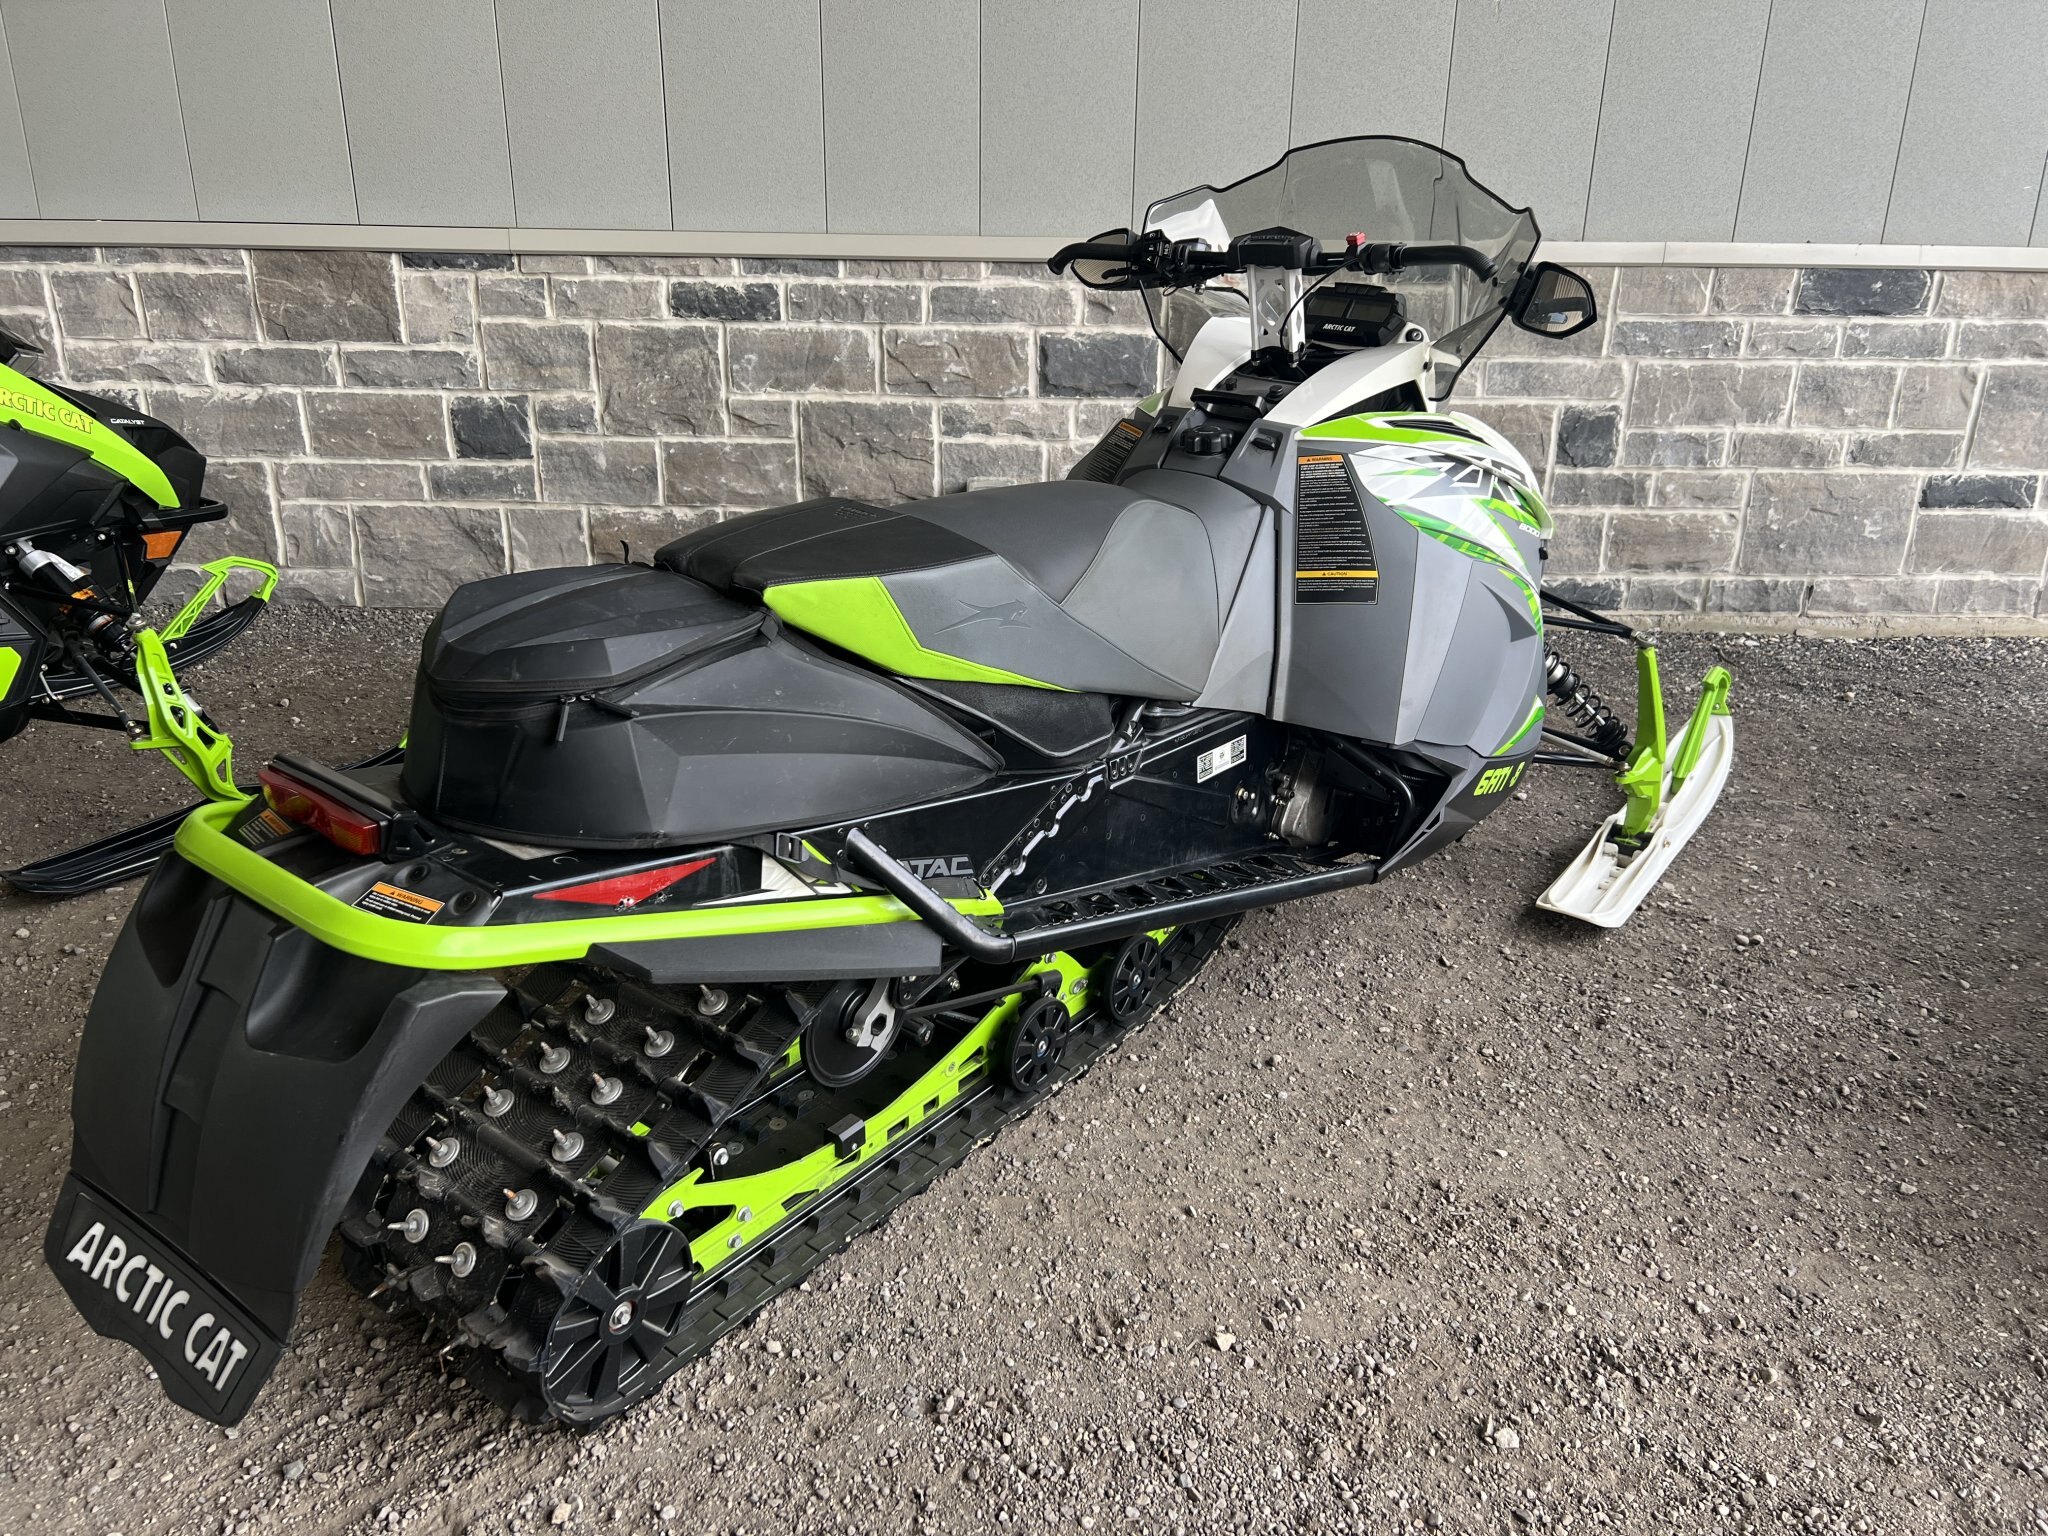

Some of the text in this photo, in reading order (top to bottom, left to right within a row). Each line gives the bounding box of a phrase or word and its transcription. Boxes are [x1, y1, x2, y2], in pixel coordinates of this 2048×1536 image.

[1322, 323, 1344, 331] ARCTIC
[58, 407, 93, 434] CAT
[396, 892, 424, 905] WARNING
[66, 1221, 248, 1392] ARCTIC CAT
